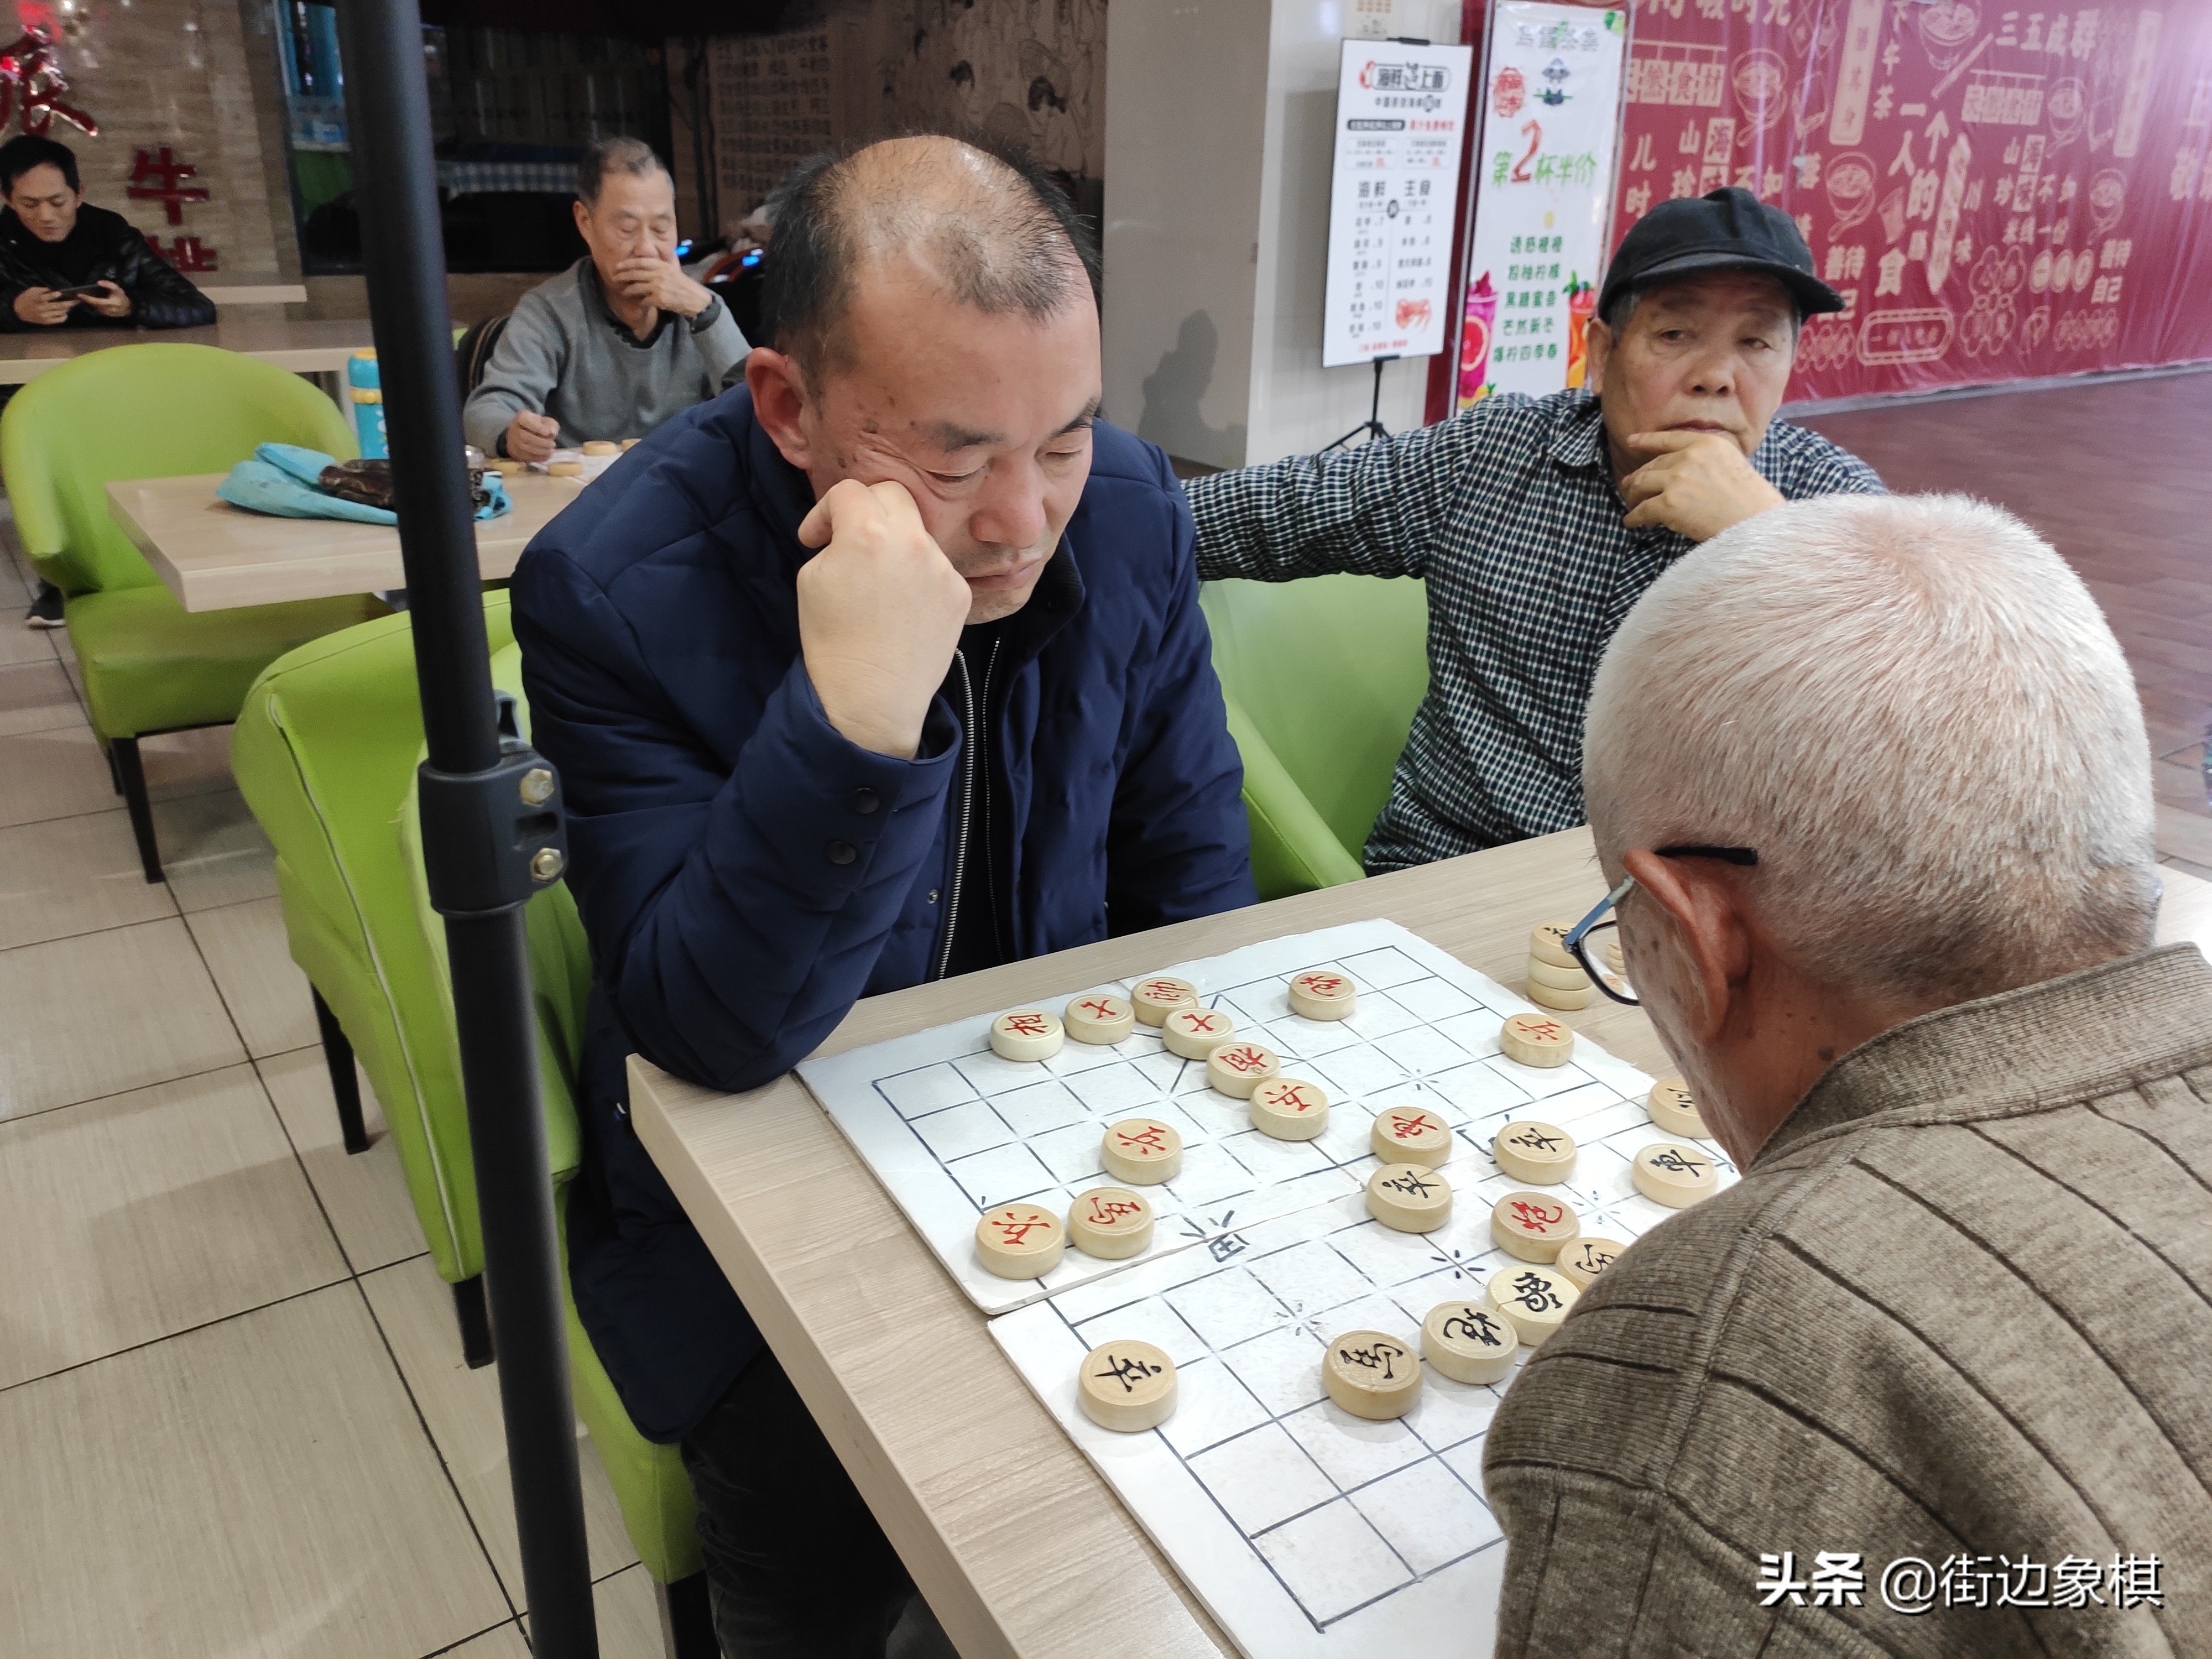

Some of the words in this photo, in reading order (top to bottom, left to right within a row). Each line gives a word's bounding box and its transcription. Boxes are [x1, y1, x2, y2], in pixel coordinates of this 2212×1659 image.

[1492, 119, 1597, 188] 第2杯半价
[1005, 1013, 1049, 1036] 相
[1517, 1021, 1561, 1040] 兵
[1265, 1084, 1310, 1112] 兵
[1117, 1126, 1166, 1155] 兵
[1510, 1128, 1562, 1152] 卒
[1382, 1171, 1439, 1199] 卒
[991, 1212, 1050, 1245] 兵
[1512, 1272, 1563, 1312] 象
[1095, 1355, 1161, 1391] 卒
